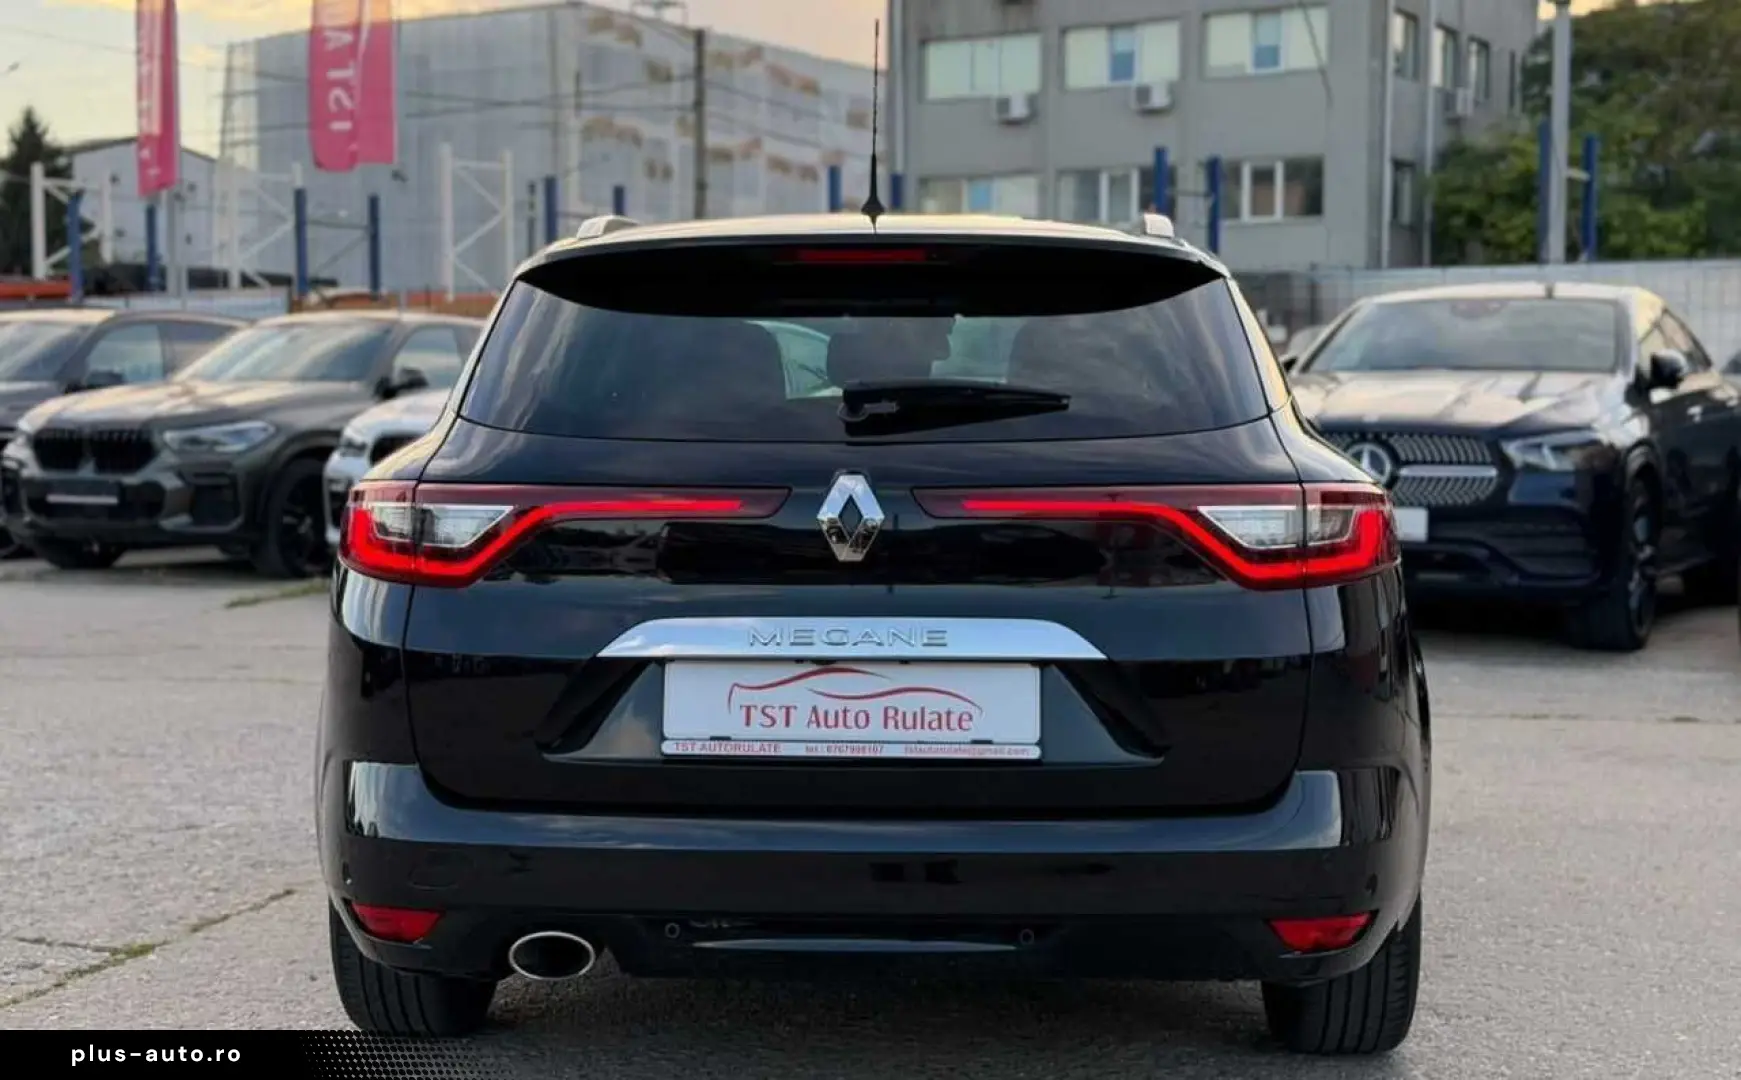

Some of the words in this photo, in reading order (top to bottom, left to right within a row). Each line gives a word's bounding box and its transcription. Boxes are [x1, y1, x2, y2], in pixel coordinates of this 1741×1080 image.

[749, 627, 948, 647] MEGANE
[739, 703, 798, 729] TST
[807, 703, 871, 730] Auto
[882, 704, 974, 731] Rulate
[674, 742, 697, 753] TST
[700, 742, 782, 754] AUTORULATE
